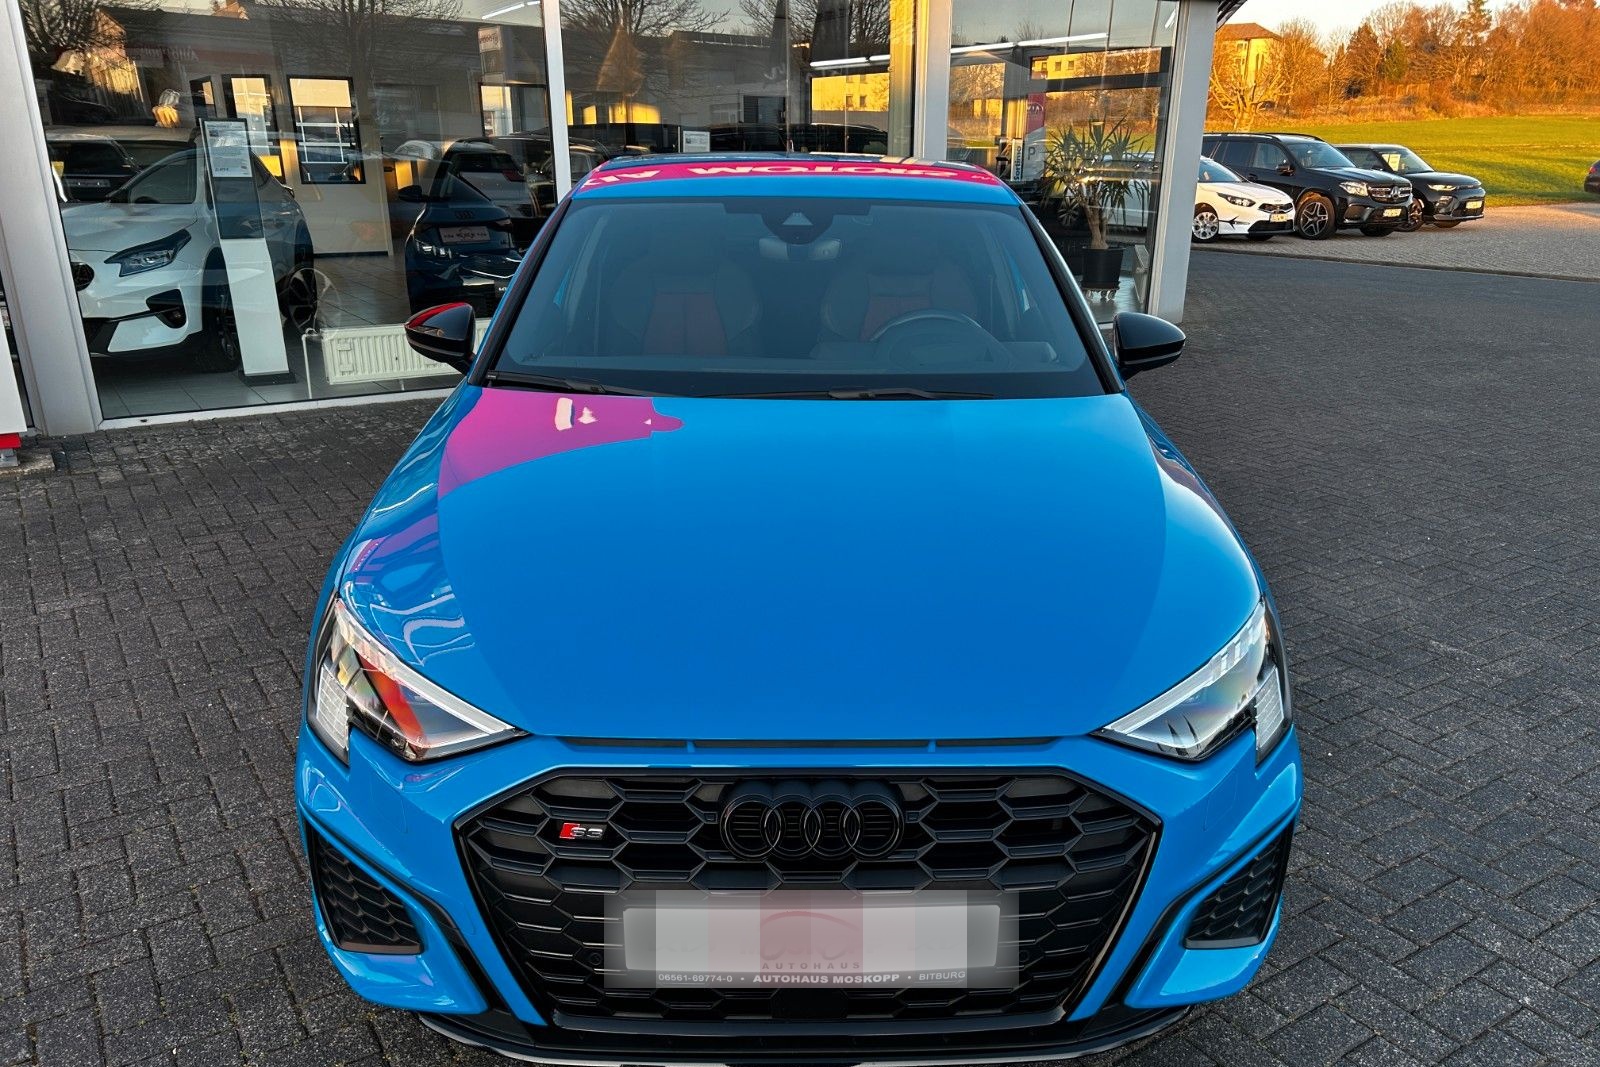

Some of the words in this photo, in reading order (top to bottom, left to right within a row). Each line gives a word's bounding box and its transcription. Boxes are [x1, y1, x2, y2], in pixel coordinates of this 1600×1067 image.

[1028, 146, 1036, 160] P
[1014, 145, 1022, 180] Sortimo
[569, 826, 603, 838] S3
[761, 961, 860, 970] AUTOHAUS
[658, 973, 733, 983] 06561-69774-0
[752, 974, 829, 984] AUTOHAUS
[832, 973, 900, 984] MOSKOPP
[918, 971, 966, 981] BITBURG
